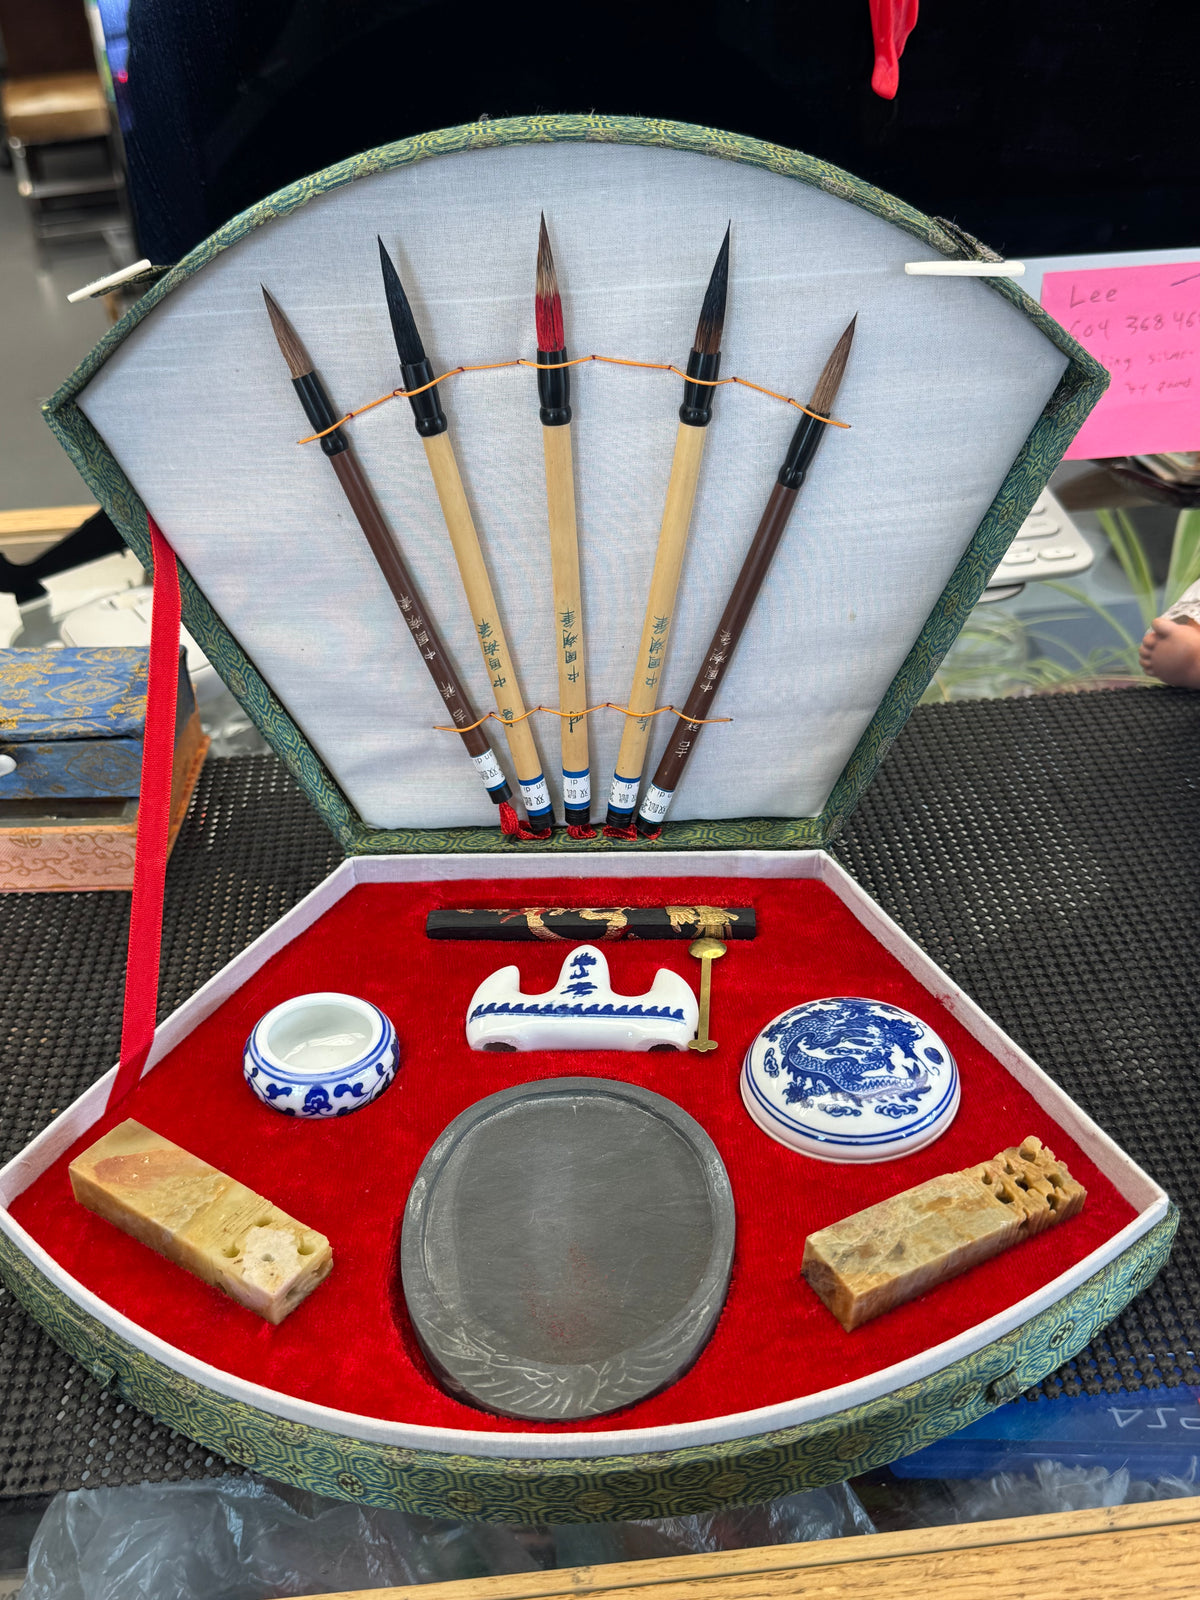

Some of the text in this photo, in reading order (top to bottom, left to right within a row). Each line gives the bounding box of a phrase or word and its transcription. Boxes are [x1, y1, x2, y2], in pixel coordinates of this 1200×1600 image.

[1069, 284, 1118, 309] Lee
[1125, 314, 1164, 336] 368
[1172, 311, 1200, 331] 46
[1107, 1407, 1200, 1429] PS4
